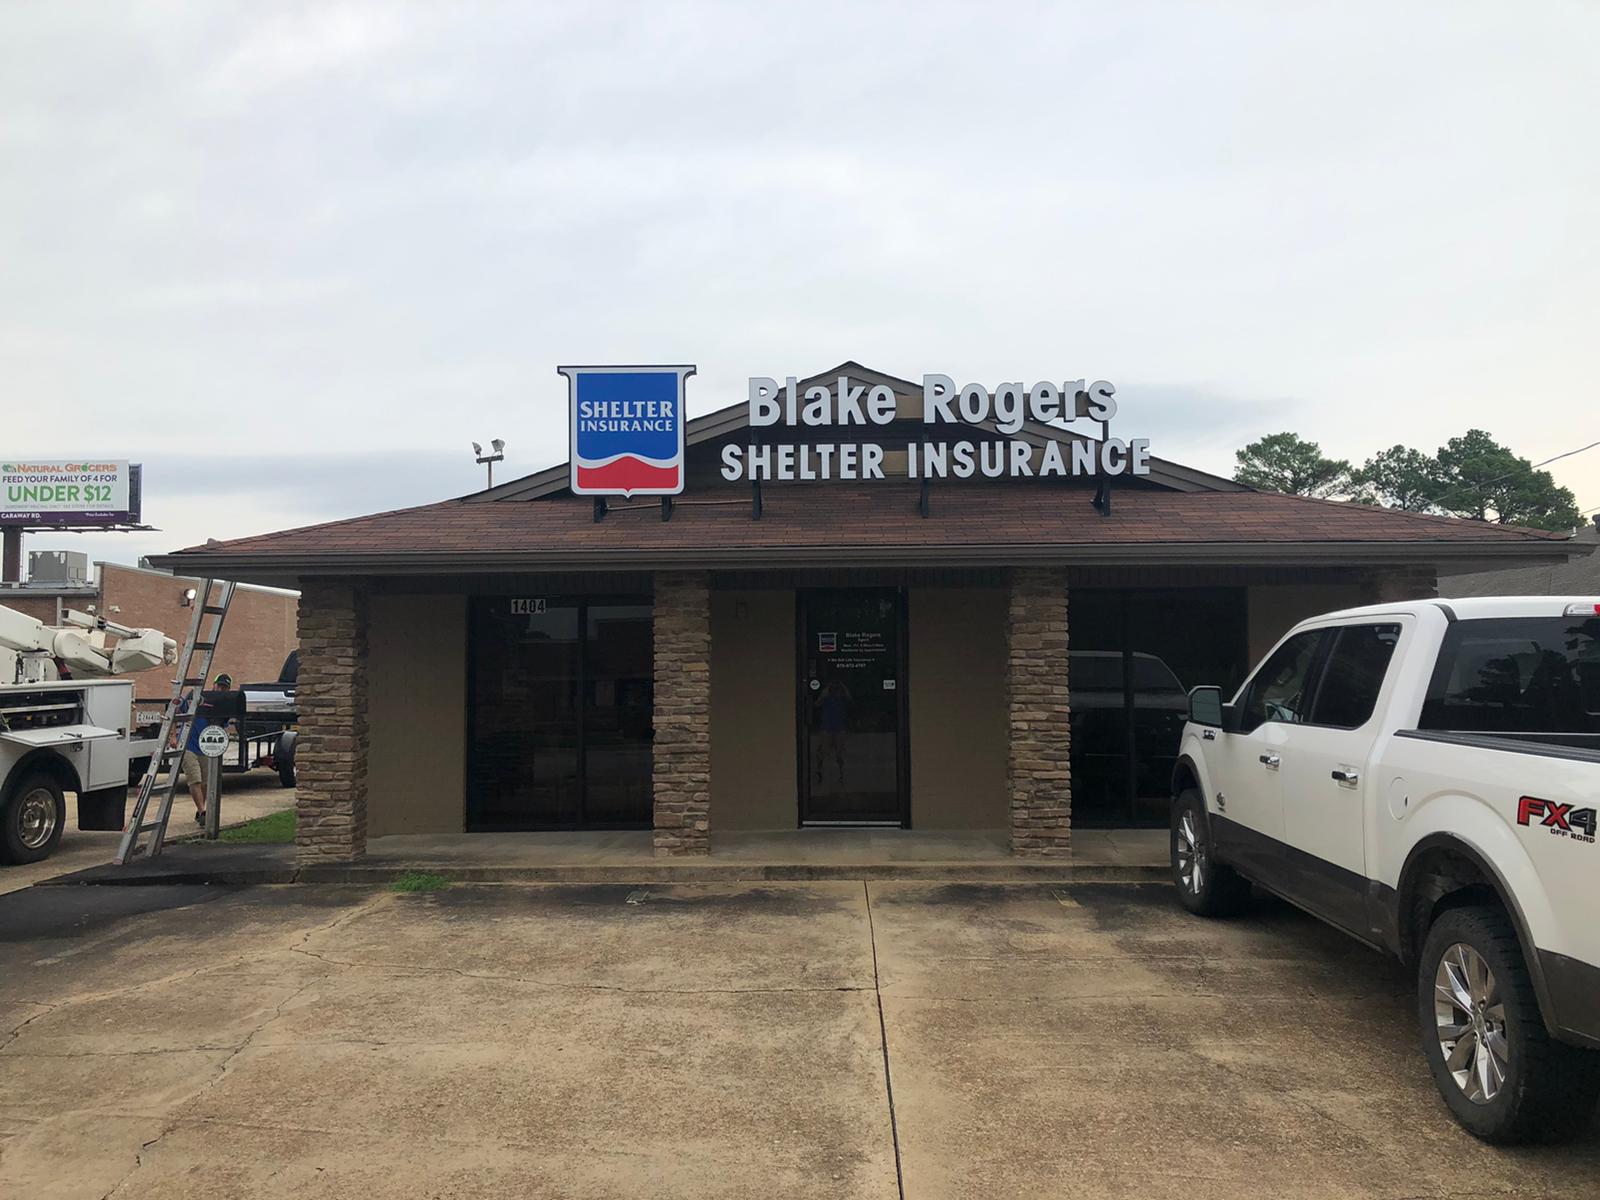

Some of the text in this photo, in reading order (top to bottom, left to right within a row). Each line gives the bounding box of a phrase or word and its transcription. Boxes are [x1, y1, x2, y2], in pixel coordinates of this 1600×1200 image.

[580, 400, 674, 418] SHELTER
[748, 373, 1117, 434] Blake Rogers
[580, 420, 673, 432] INSURANCE
[720, 438, 1151, 481] SHELTER INSURANCE
[3, 475, 23, 484] FEED
[25, 475, 48, 483] YOUR
[50, 475, 78, 483] FAMILY
[100, 474, 117, 482] FOR
[8, 485, 80, 502] UNDER
[513, 599, 545, 613] 1404
[1517, 795, 1598, 837] FX4
[1550, 828, 1596, 844] OFF ROAD
